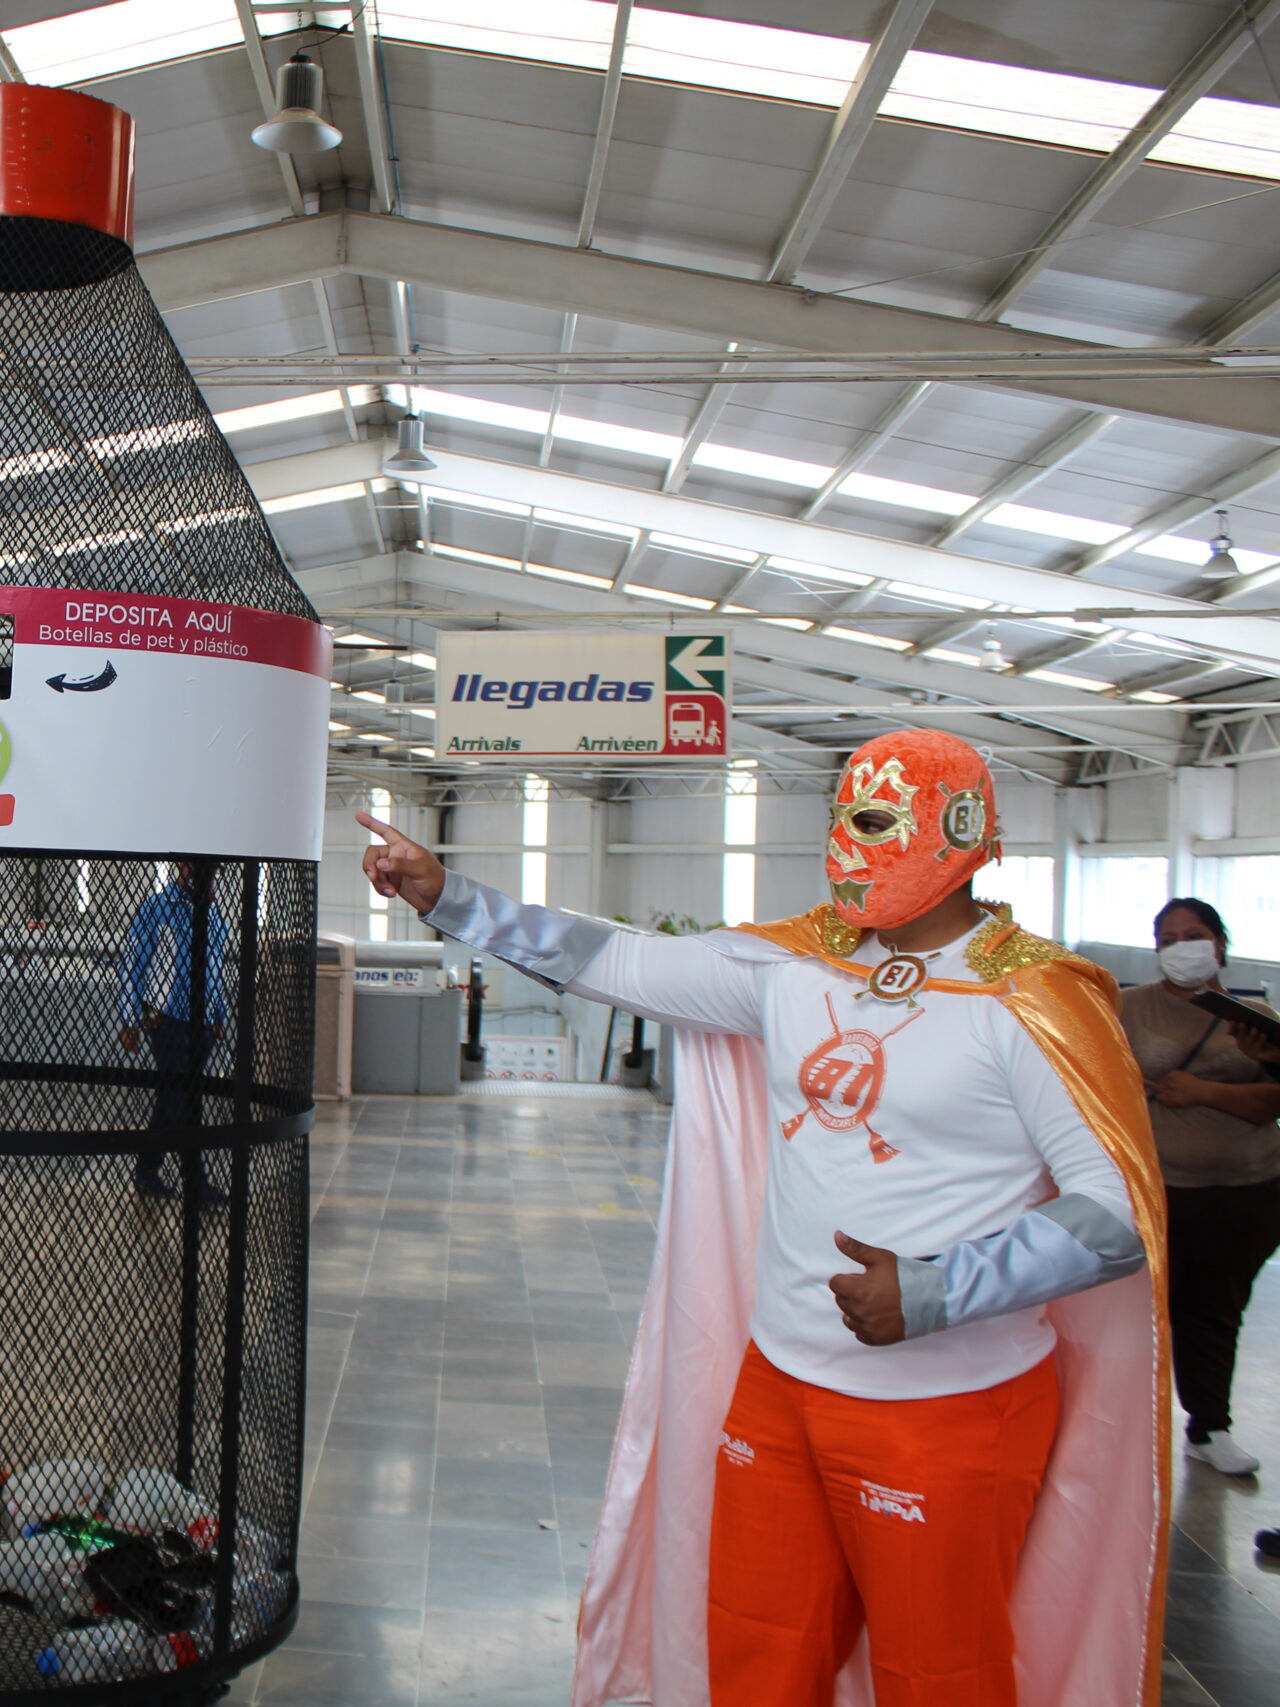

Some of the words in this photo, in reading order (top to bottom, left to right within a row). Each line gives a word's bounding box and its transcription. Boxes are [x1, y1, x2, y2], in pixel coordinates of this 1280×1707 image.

[65, 601, 173, 629] DEPOSITA
[185, 610, 233, 634] AQUÍ
[39, 625, 113, 644] Botellas
[119, 629, 141, 646] de
[147, 633, 175, 650] pet
[179, 638, 189, 652] y
[194, 636, 249, 657] plástico
[451, 674, 655, 710] llegadas
[447, 736, 522, 752] Arrivals
[576, 736, 659, 752] Arrivéen
